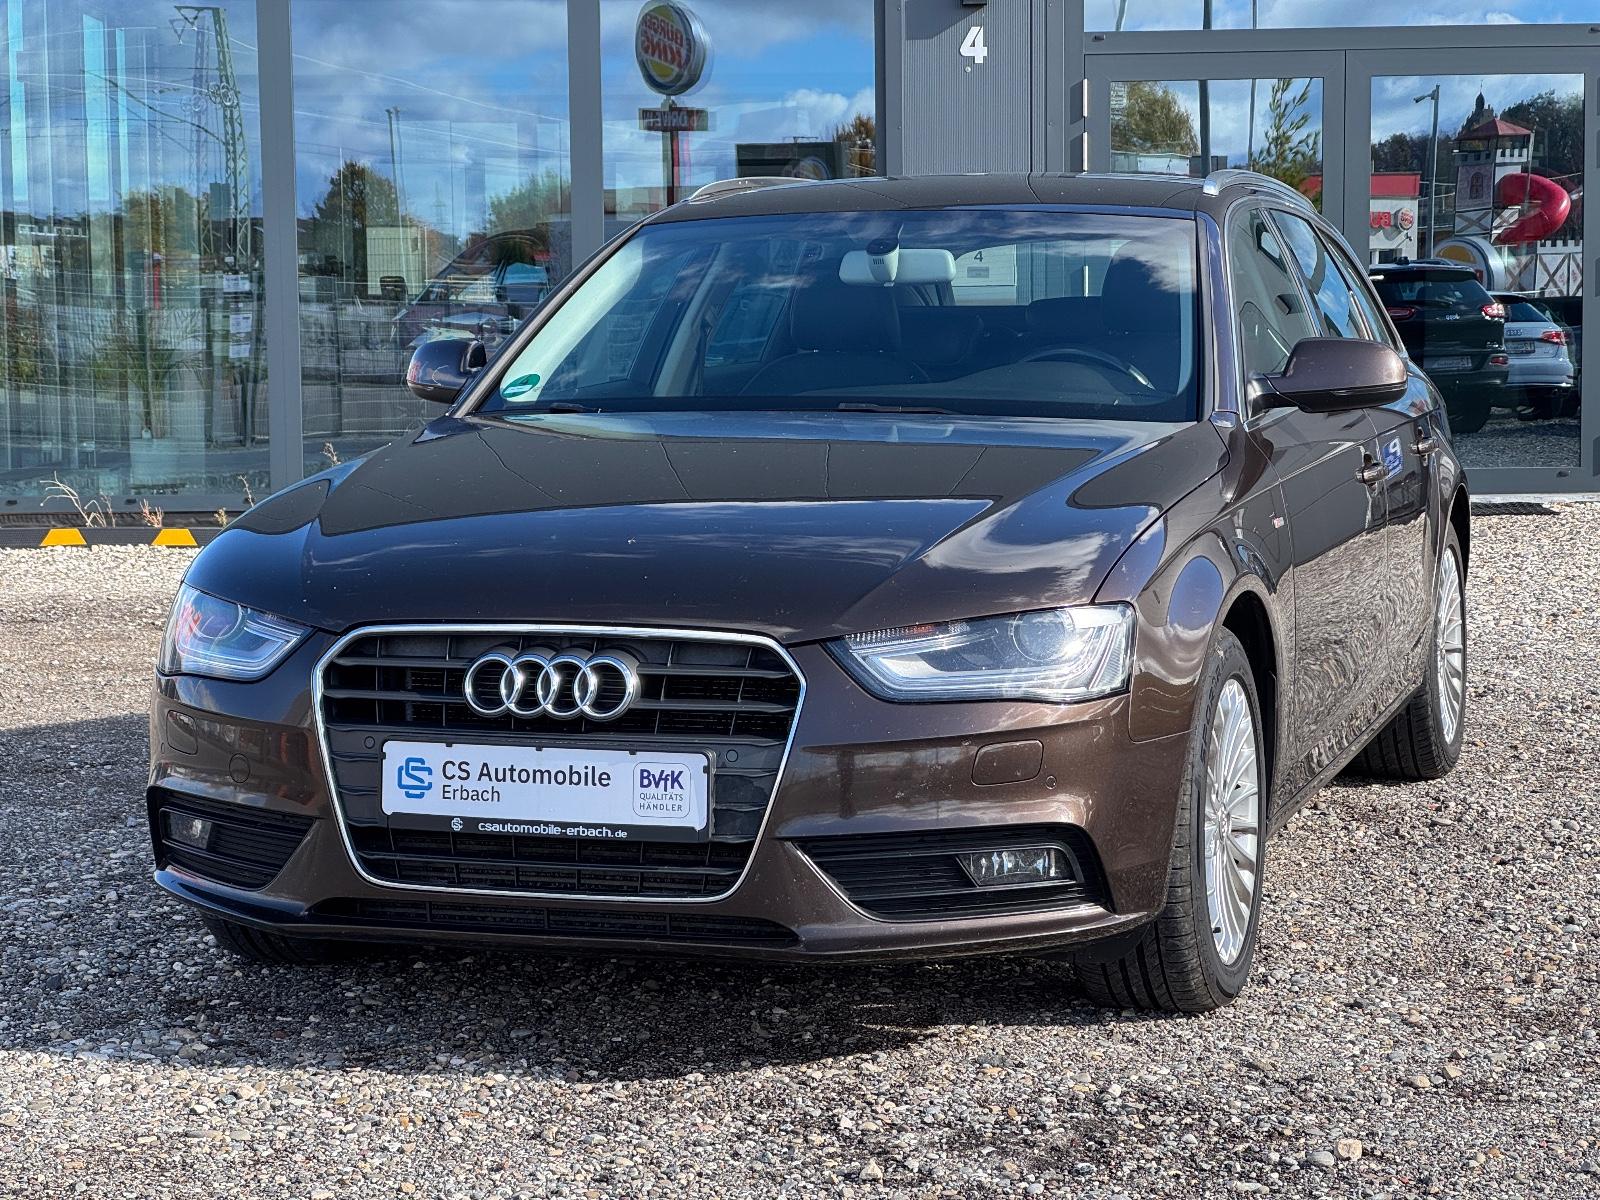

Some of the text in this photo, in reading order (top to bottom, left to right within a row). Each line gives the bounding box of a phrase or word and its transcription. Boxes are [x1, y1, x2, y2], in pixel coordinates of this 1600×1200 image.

[960, 26, 987, 63] 4
[974, 250, 984, 262] 4
[442, 760, 611, 787] CS Automobile
[639, 768, 685, 792] BVfK
[442, 784, 500, 802] Erbach
[639, 791, 684, 801] QUALITÄTS
[639, 801, 683, 812] HÄNDLER
[478, 821, 628, 839] csautomobile-erbach.de
